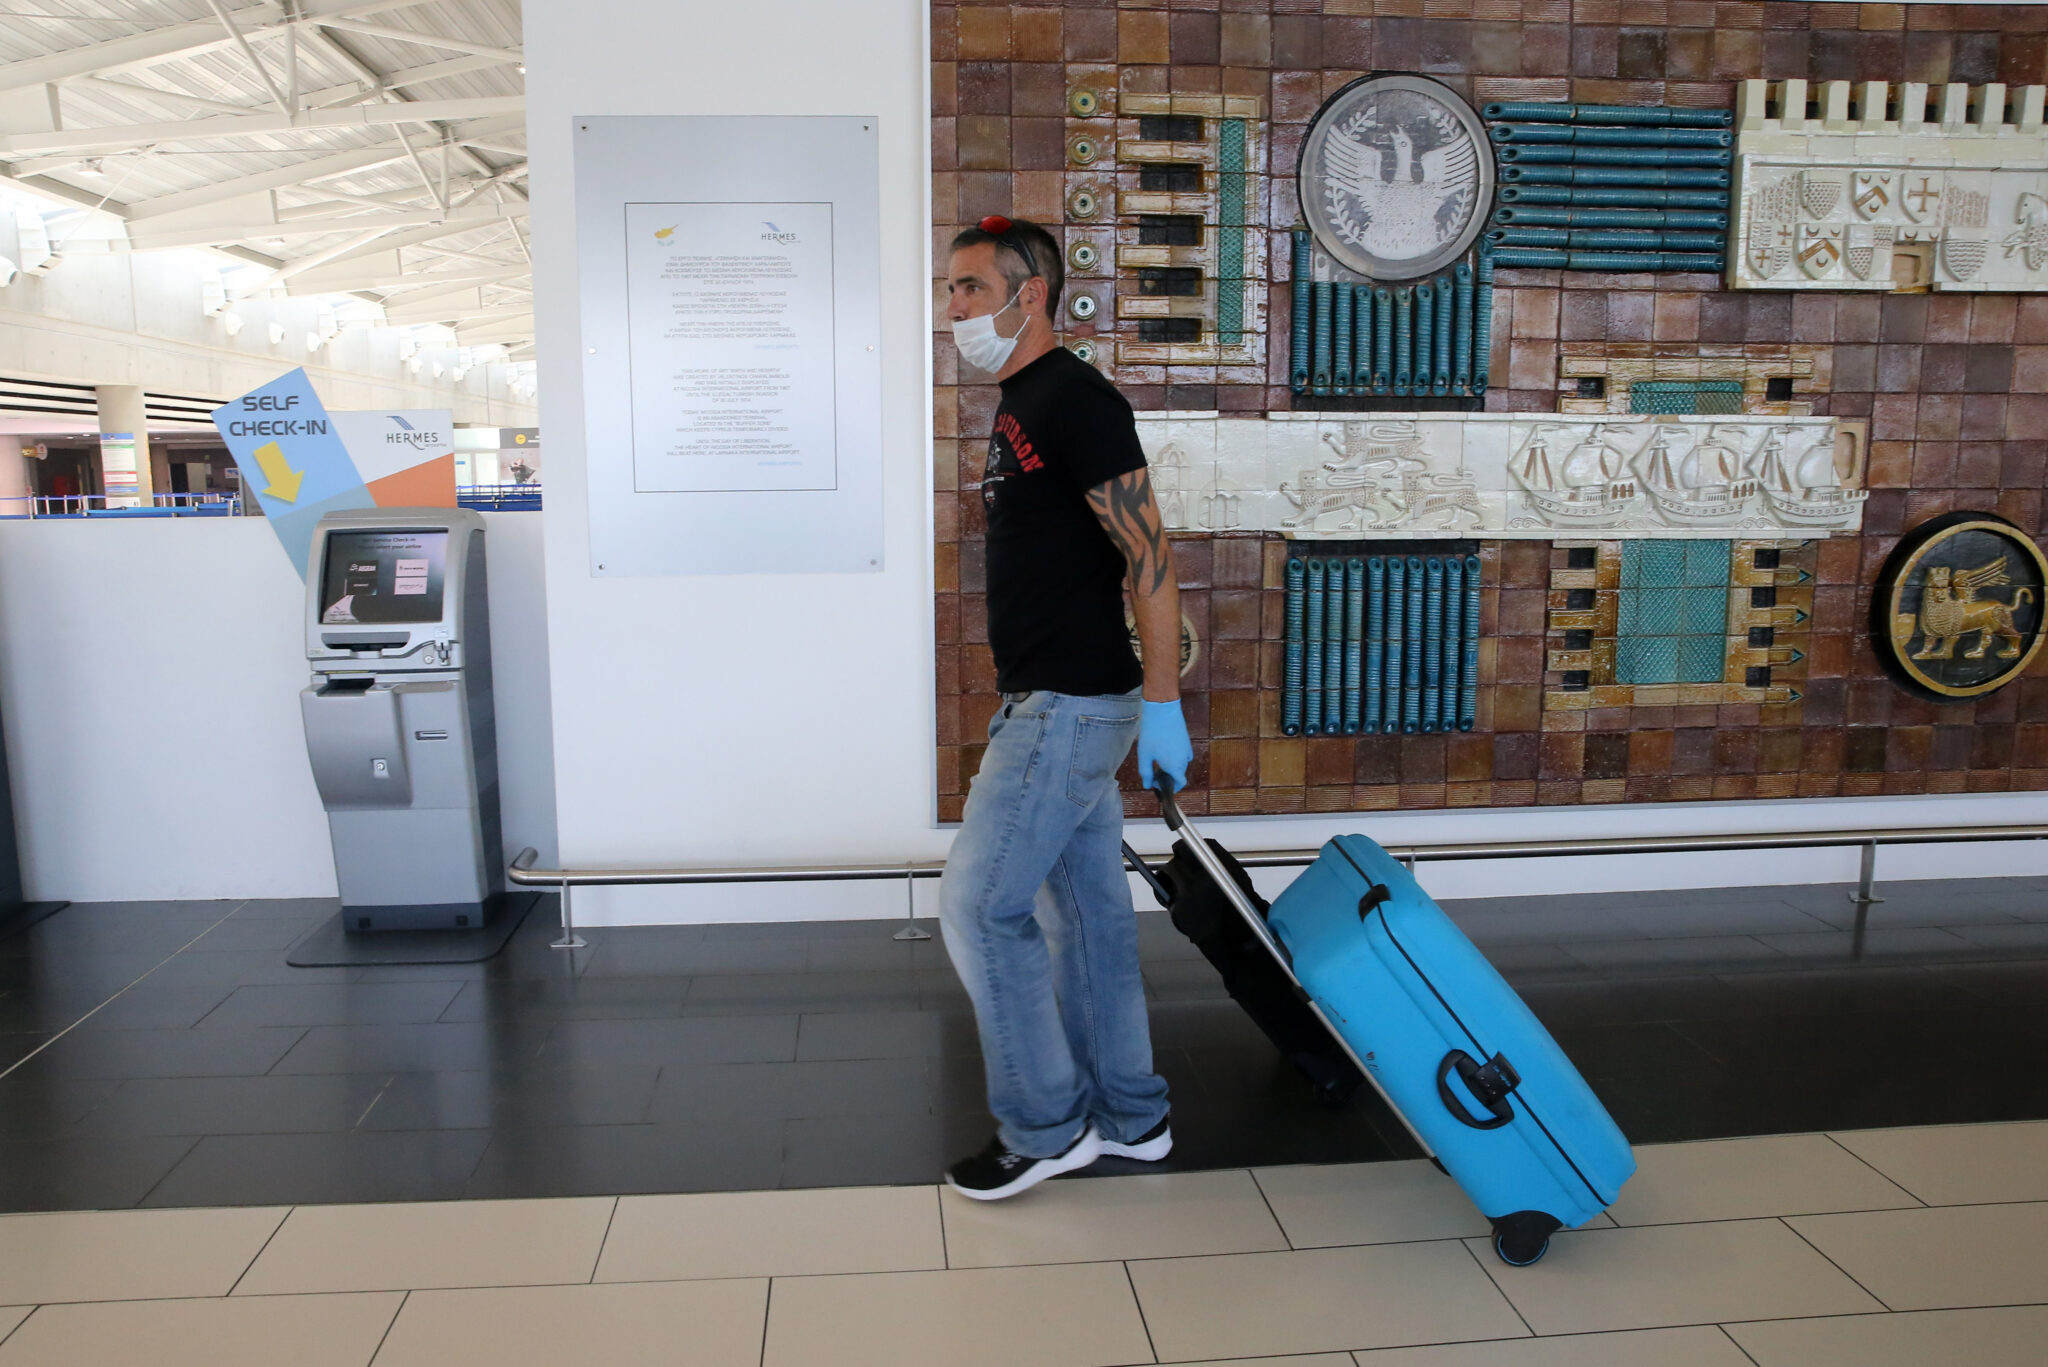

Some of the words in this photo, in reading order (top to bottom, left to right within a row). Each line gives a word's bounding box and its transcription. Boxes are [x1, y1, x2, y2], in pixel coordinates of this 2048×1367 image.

[761, 233, 796, 243] HERMES
[242, 395, 299, 411] SELF
[229, 420, 327, 436] CHECK-IN
[386, 432, 439, 447] HERMES
